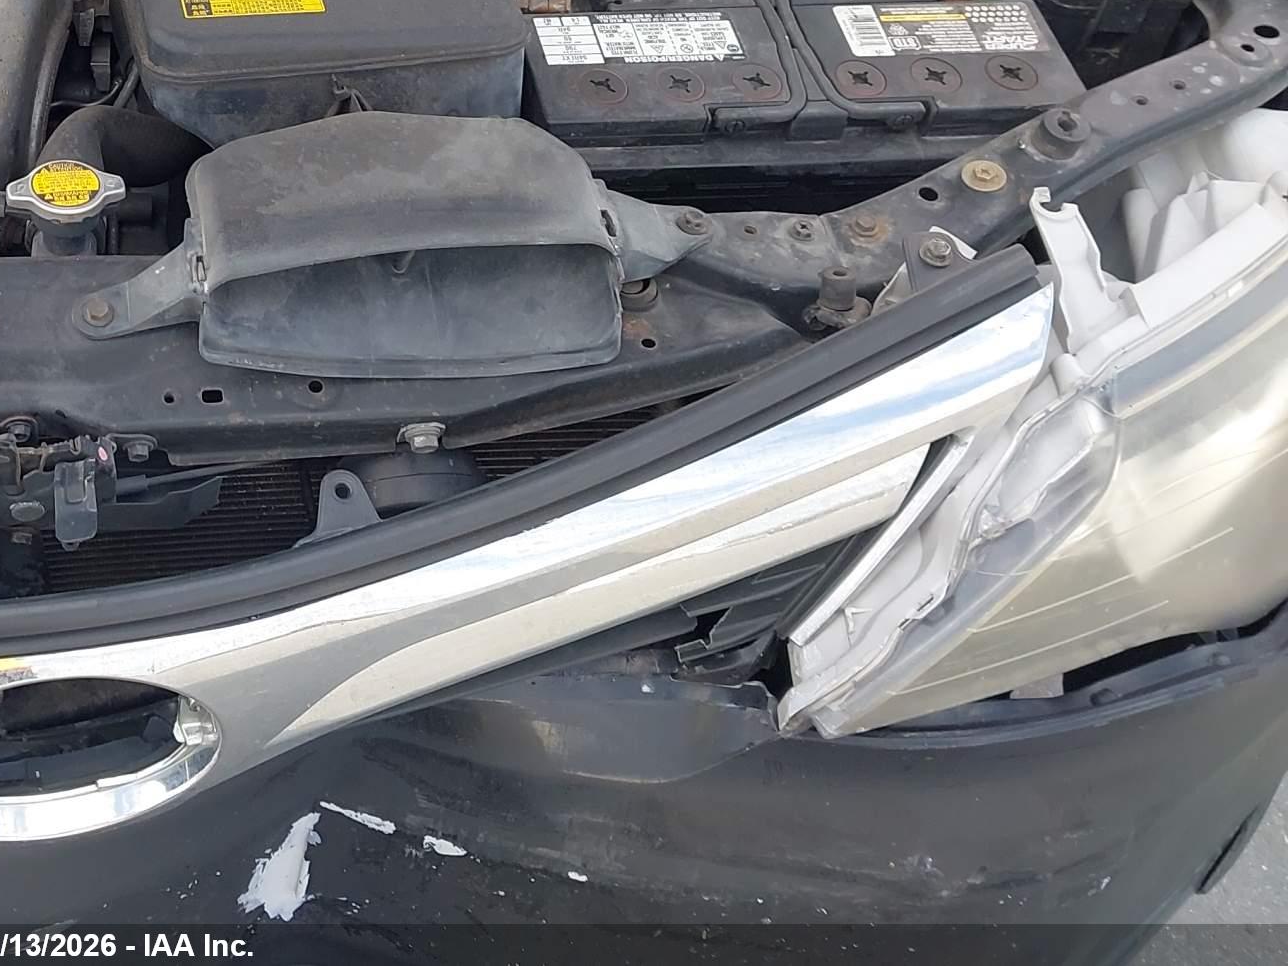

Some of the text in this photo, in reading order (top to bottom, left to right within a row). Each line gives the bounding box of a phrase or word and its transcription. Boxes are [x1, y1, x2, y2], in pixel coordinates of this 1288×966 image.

[893, 37, 916, 47] STD
[980, 35, 1039, 44] START
[984, 43, 1037, 51] SUPER
[624, 55, 714, 63] DANGER/POISON
